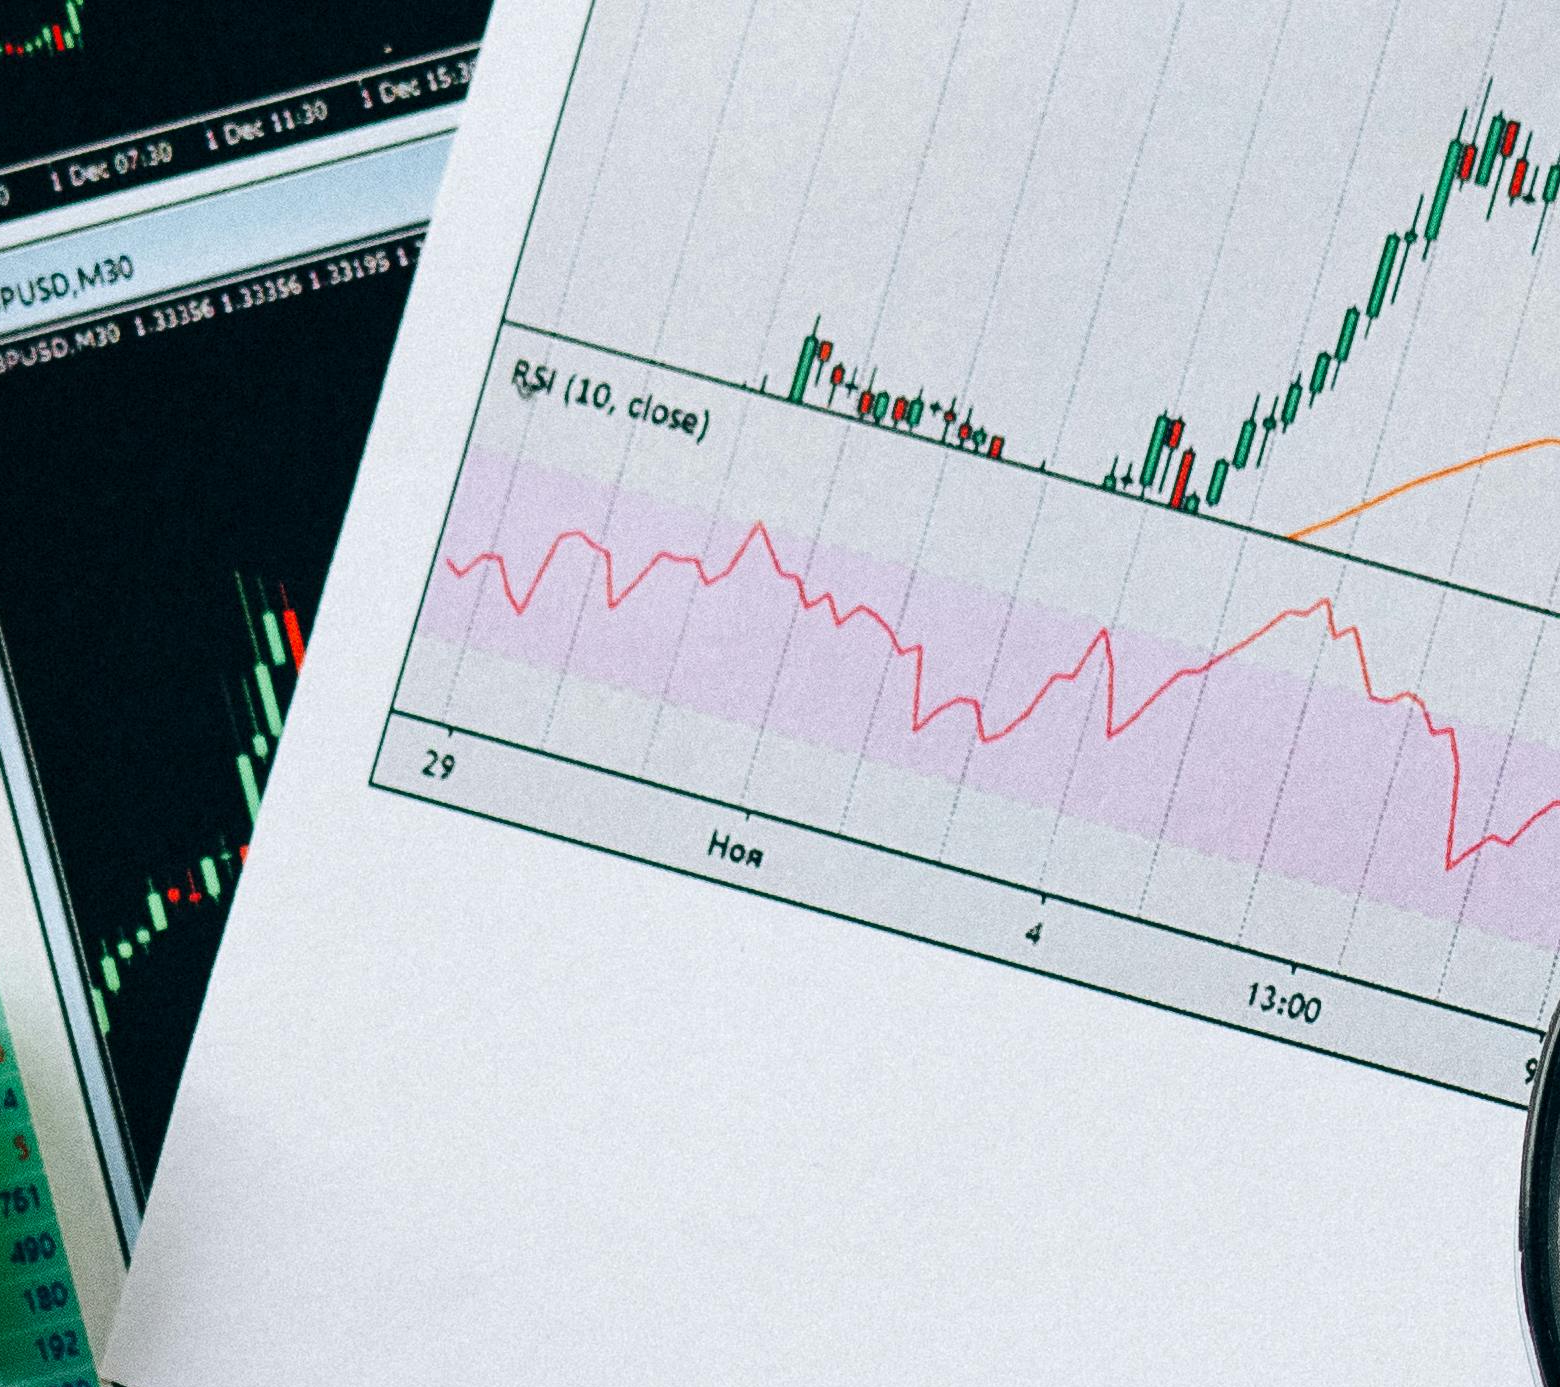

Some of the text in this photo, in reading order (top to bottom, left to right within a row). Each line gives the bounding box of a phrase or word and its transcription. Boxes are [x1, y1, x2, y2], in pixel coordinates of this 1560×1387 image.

[378, 77, 422, 105] Dec
[222, 118, 266, 147] Dec
[67, 160, 111, 188] Dec
[564, 373, 617, 416] (10,
[627, 393, 711, 446] close)
[421, 749, 458, 782] 29
[707, 829, 766, 870] Ноя
[1024, 921, 1045, 945] 4
[1247, 981, 1324, 1026] 13:00
[35, 1329, 81, 1365] 192
